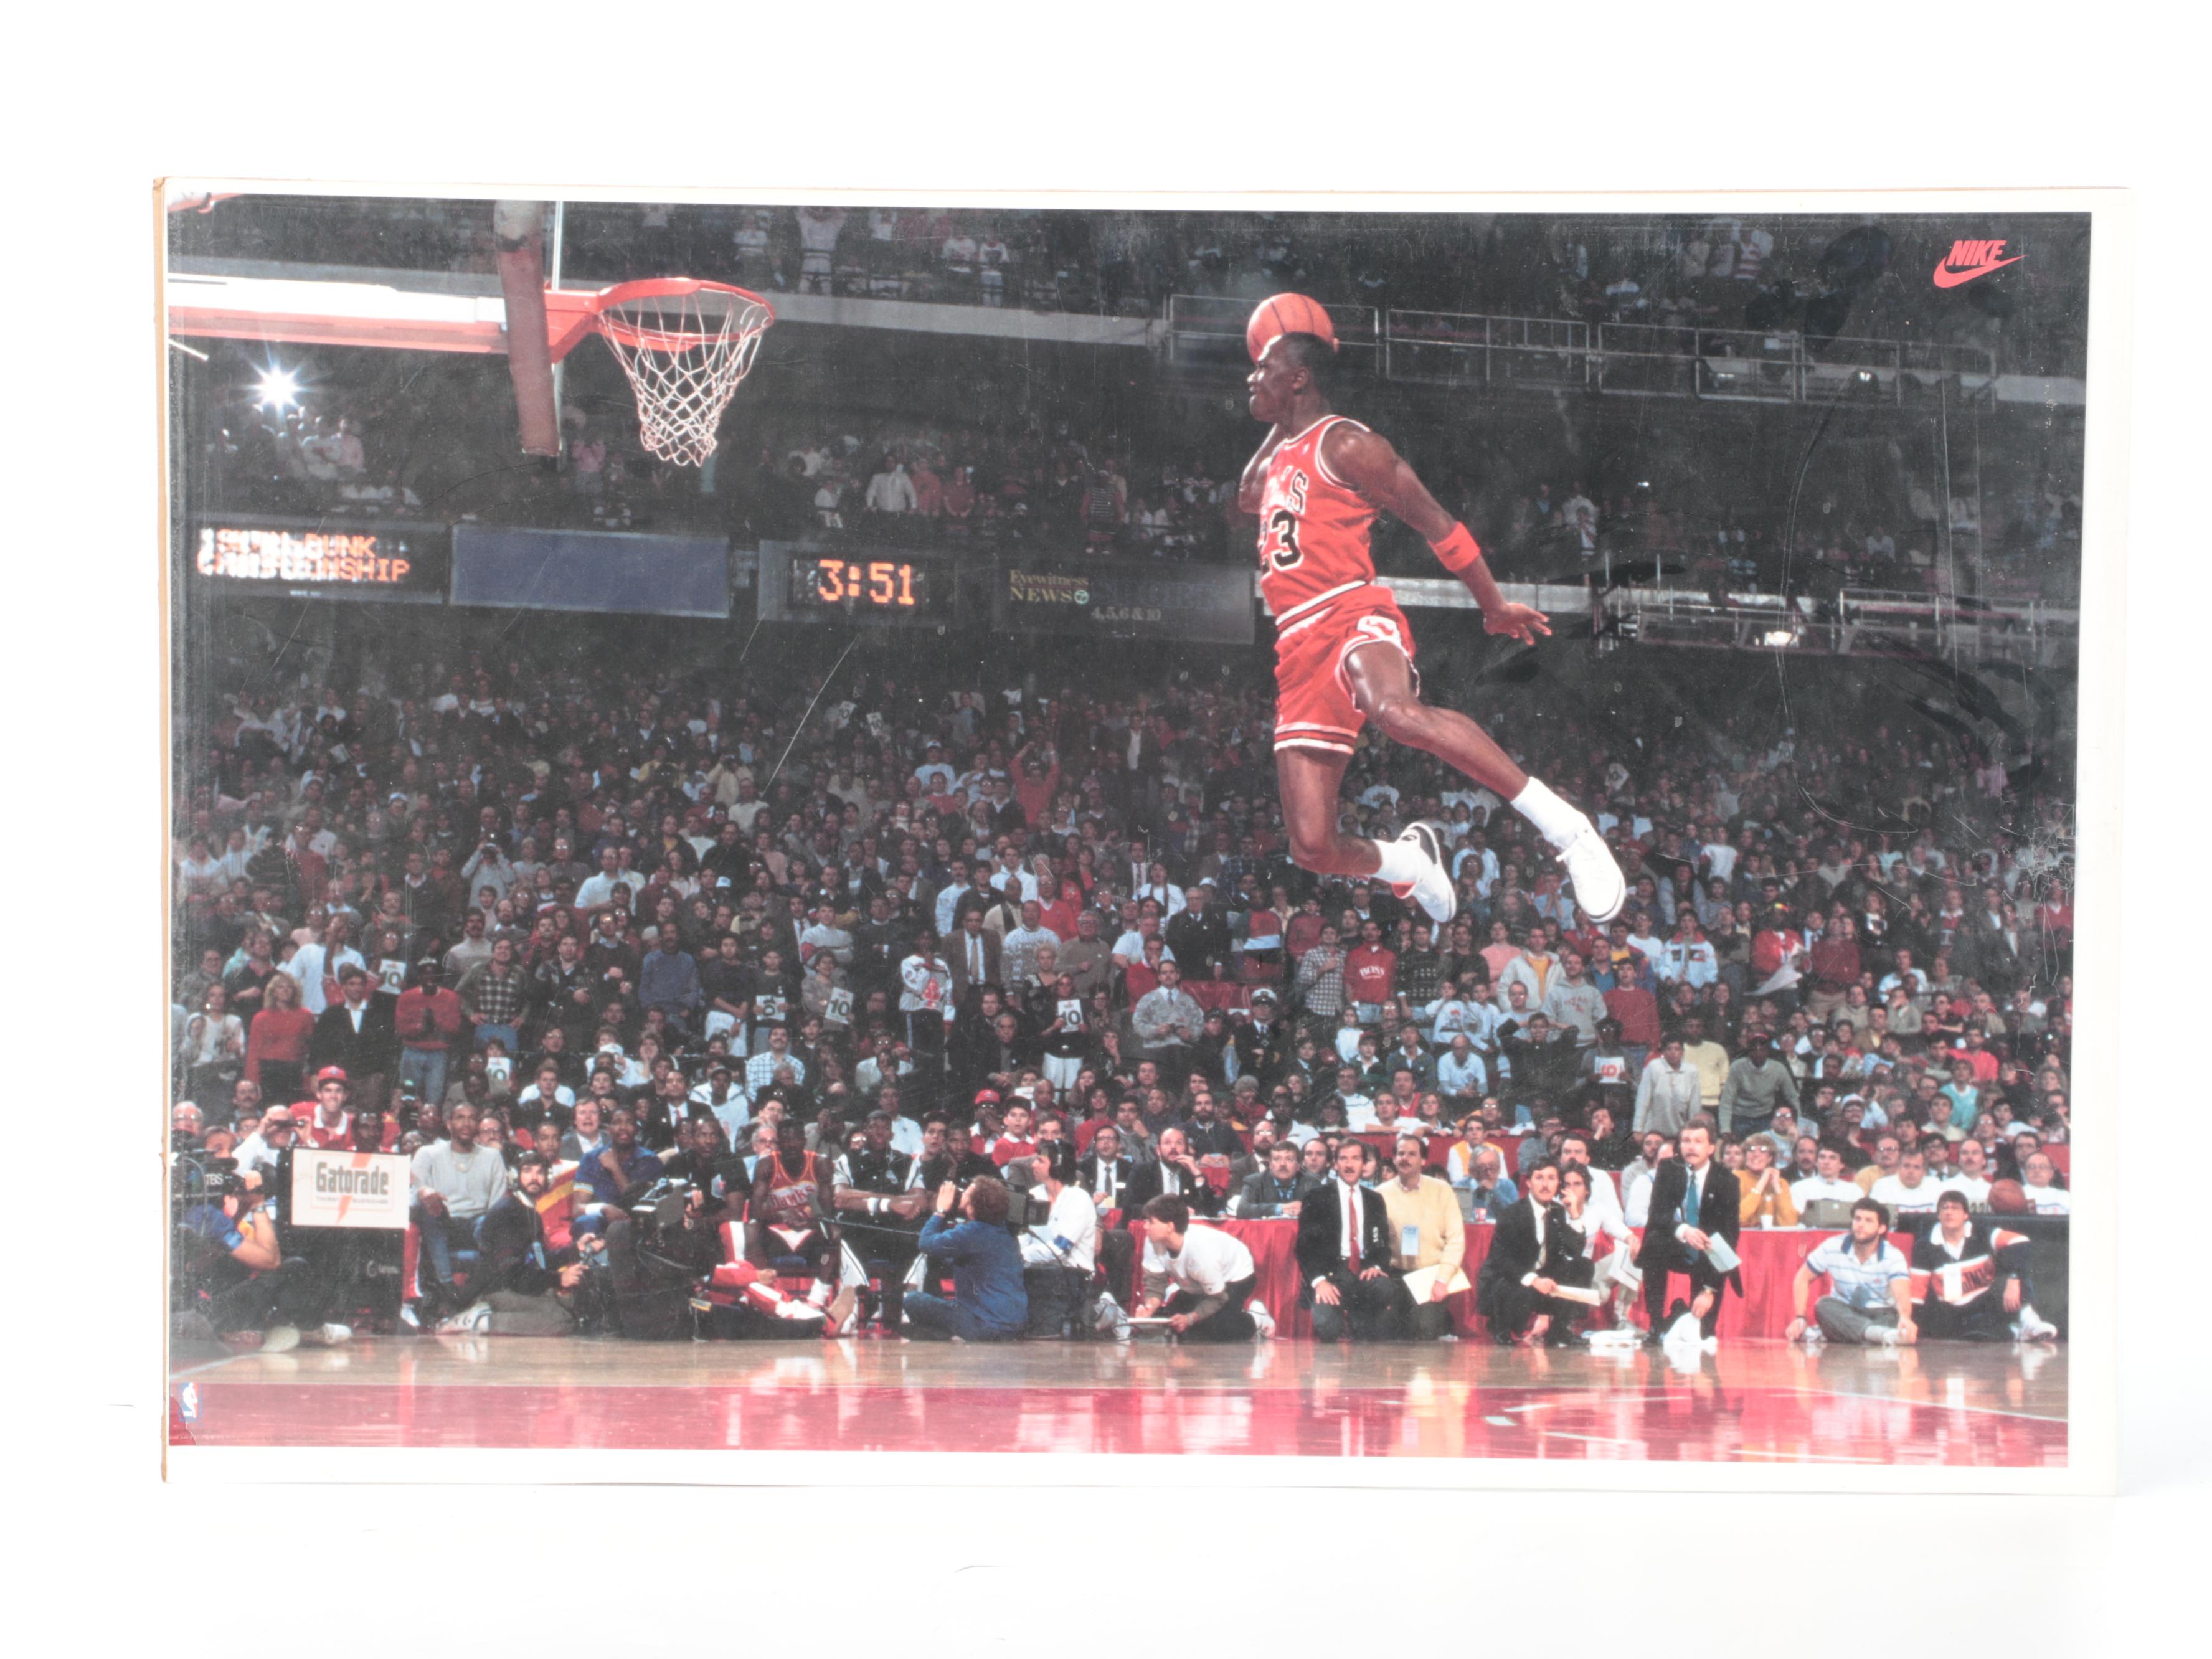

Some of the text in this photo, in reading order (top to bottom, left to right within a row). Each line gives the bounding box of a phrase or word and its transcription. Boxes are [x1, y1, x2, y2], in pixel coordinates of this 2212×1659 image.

[1946, 240, 2006, 266] NIKE
[818, 559, 915, 605] 3:51
[1009, 587, 1072, 603] NEWS
[830, 998, 850, 1017] 10
[316, 1161, 389, 1195] Gatorade
